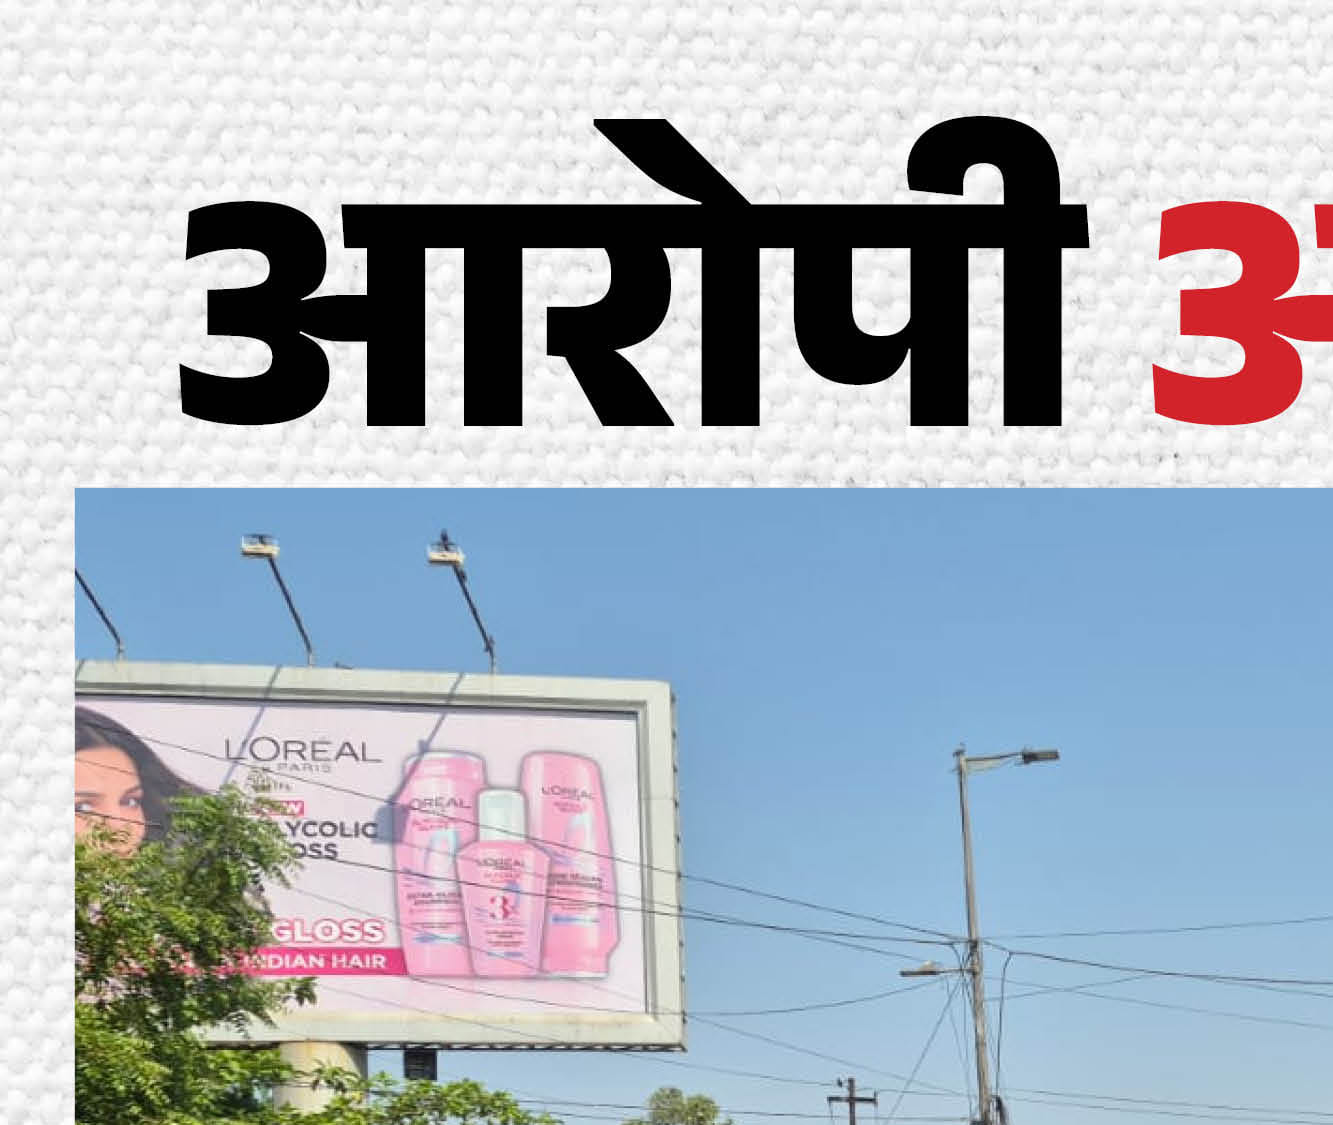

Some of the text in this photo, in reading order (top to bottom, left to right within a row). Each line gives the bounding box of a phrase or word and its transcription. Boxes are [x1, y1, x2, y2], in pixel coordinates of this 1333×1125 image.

[277, 763, 331, 773] PARIS
[284, 820, 378, 839] YCOLIC
[291, 843, 339, 860] OSS
[271, 918, 386, 944] GLOSS
[331, 953, 387, 969] HAIR
